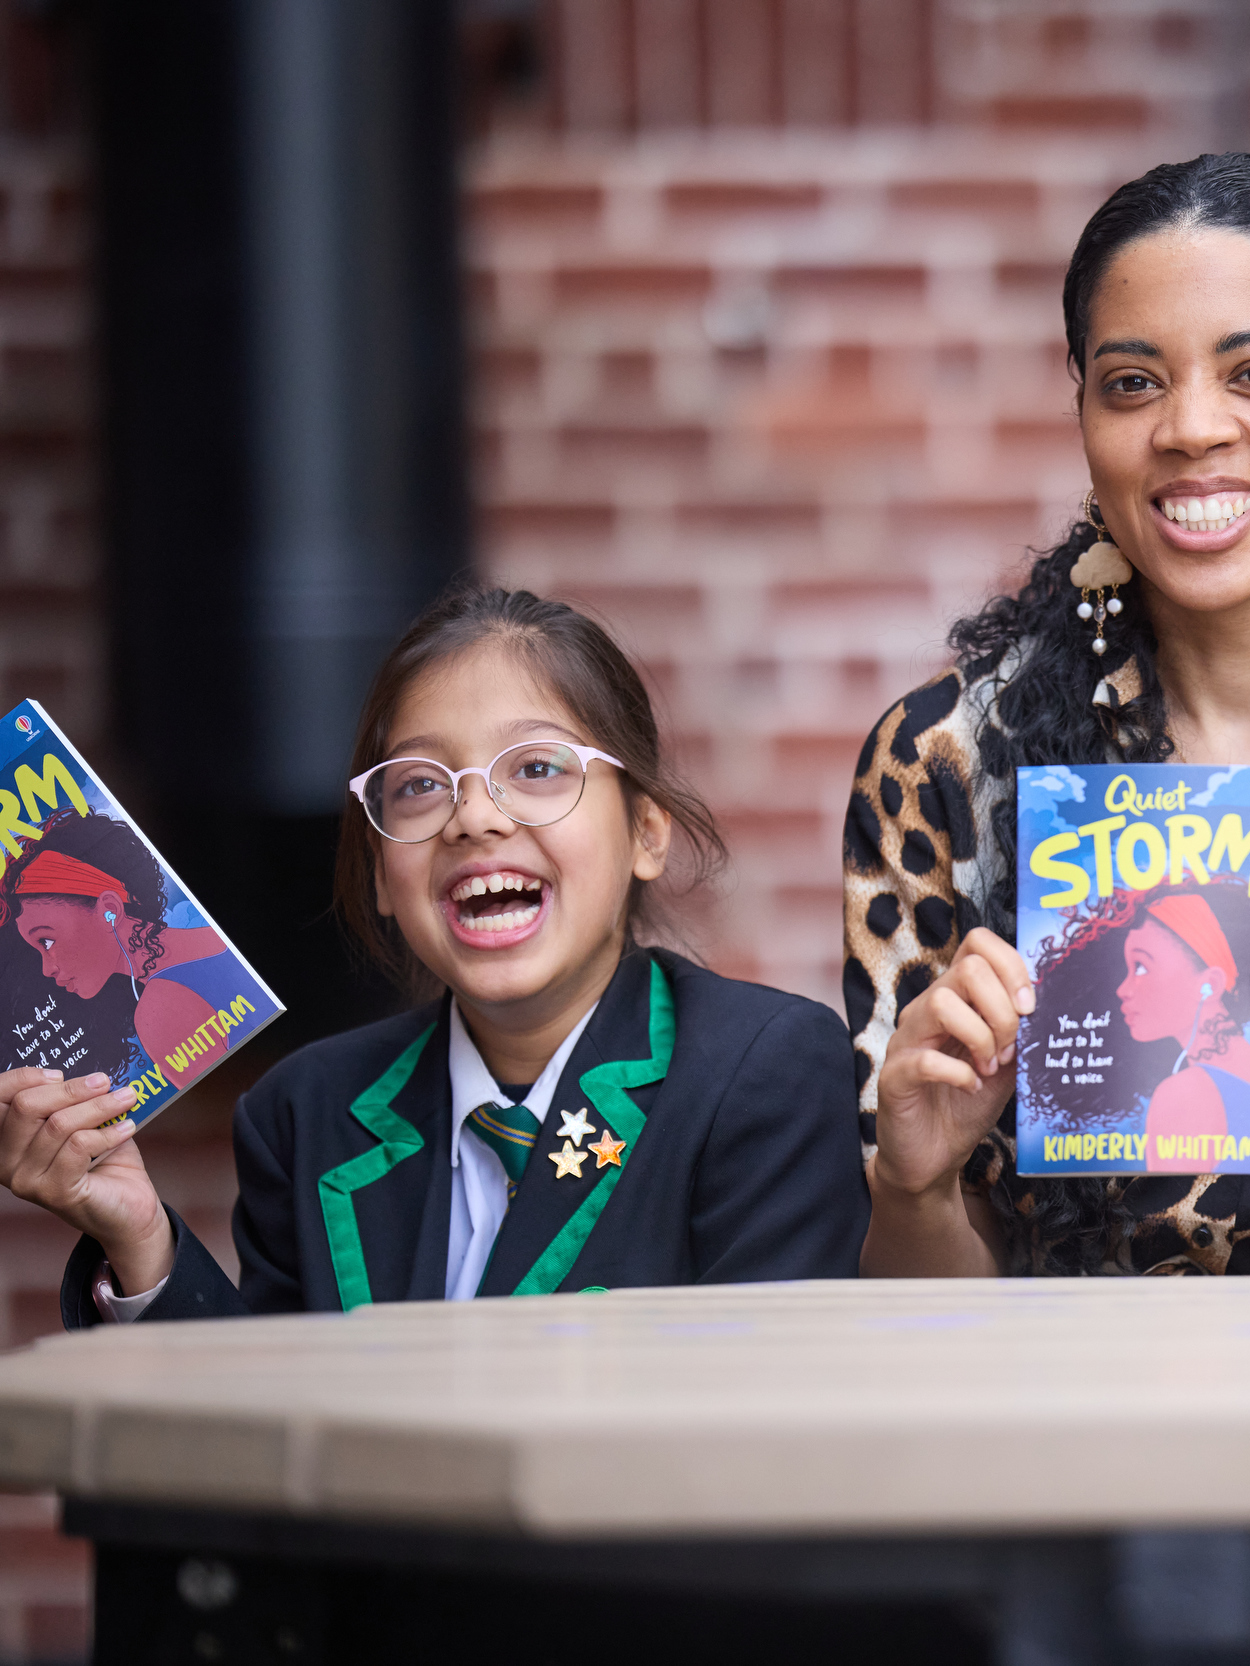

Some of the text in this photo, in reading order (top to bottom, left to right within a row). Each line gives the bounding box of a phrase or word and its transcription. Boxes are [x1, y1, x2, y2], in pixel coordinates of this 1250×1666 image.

[1104, 774, 1192, 816] Quiet
[12, 994, 57, 1041] You don't
[1058, 1014, 1079, 1033] You
[16, 1019, 65, 1060] have to be
[49, 1047, 61, 1060] to
[60, 1026, 85, 1049] have
[165, 994, 256, 1073] WHITTAM
[1048, 1030, 1104, 1049] have to be
[62, 1047, 89, 1069] voice
[1071, 1055, 1084, 1069] to
[1087, 1052, 1114, 1068] have
[1061, 1074, 1070, 1084] a
[1044, 1132, 1149, 1162] KIMBERLY
